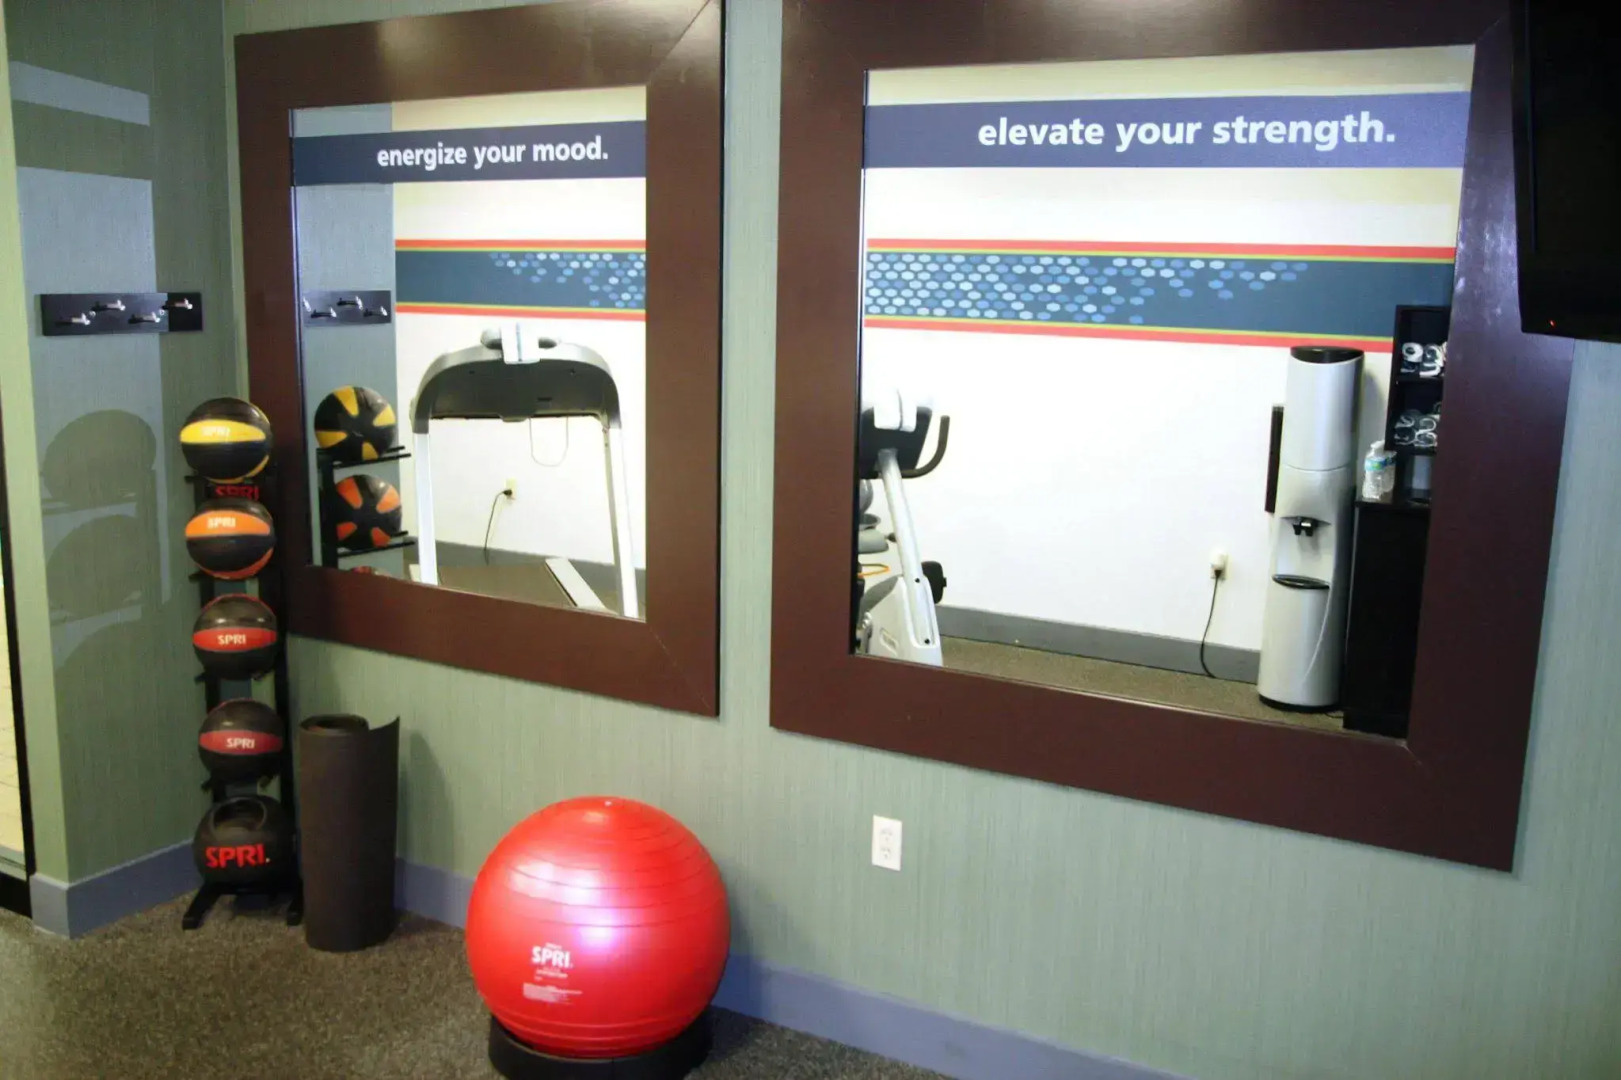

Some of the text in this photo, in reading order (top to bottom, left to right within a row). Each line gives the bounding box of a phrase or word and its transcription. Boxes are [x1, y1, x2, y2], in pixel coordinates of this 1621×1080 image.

[978, 111, 1396, 152] elevate your strength.
[377, 134, 608, 171] energize your mood.
[207, 516, 237, 529] SPRI
[217, 633, 247, 645] SPRI
[225, 737, 256, 749] SPRI
